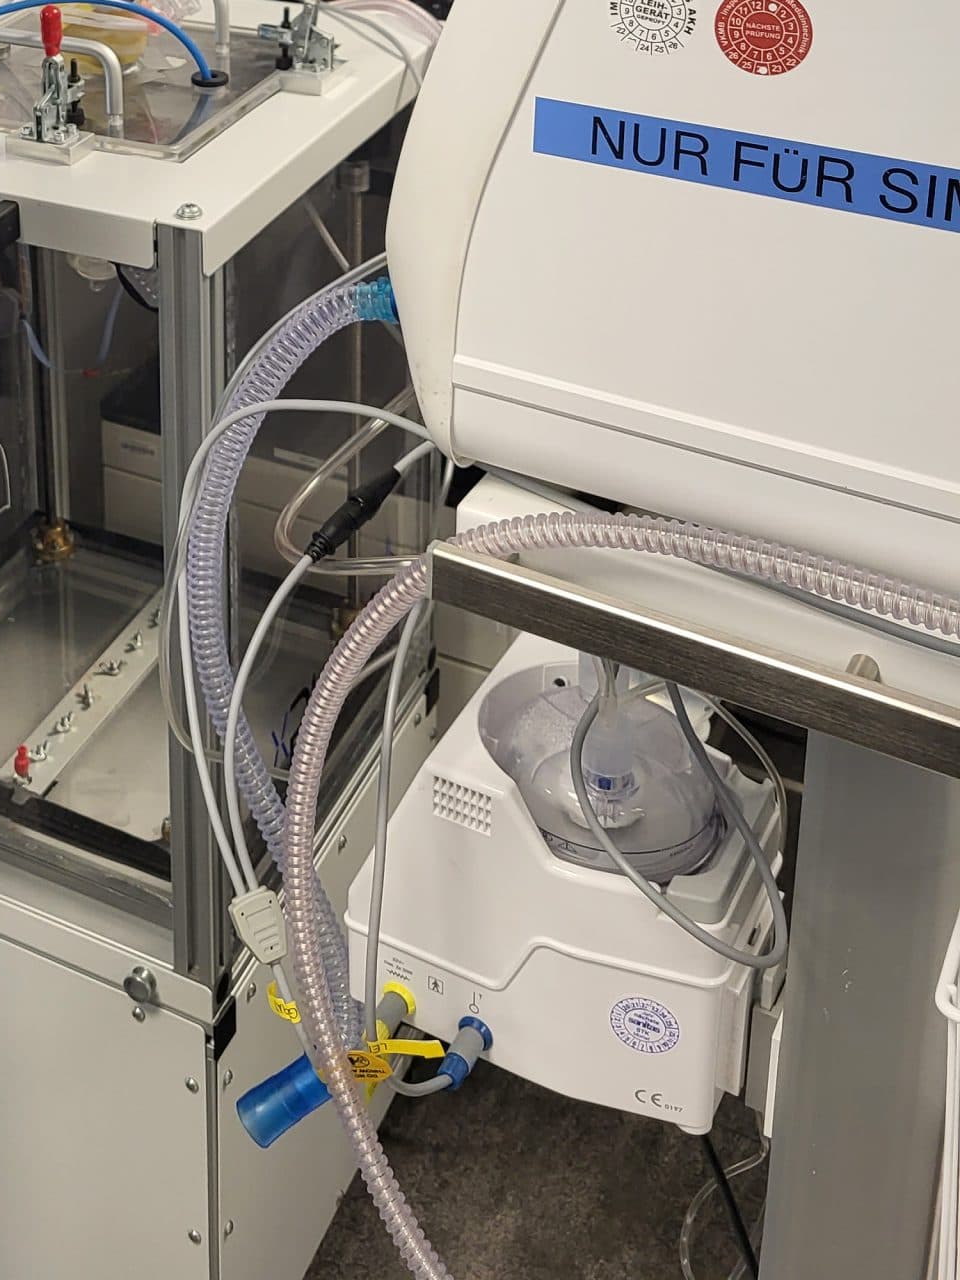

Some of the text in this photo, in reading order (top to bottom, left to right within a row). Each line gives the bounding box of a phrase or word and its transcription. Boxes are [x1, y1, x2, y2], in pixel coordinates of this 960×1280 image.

[751, 1, 762, 10] 12
[780, 9, 787, 18] 2
[610, 2, 618, 16] IM
[684, 8, 696, 35] AKH
[628, 19, 634, 27] 8
[731, 17, 742, 26] 10
[788, 22, 794, 31] 3
[664, 30, 670, 38] 5
[733, 30, 740, 39] 9
[639, 43, 650, 52] 24
[740, 42, 746, 51] 8
[779, 46, 785, 55] 5
[766, 52, 772, 60] 6
[591, 116, 710, 177] NUR
[732, 140, 855, 204] FÜR
